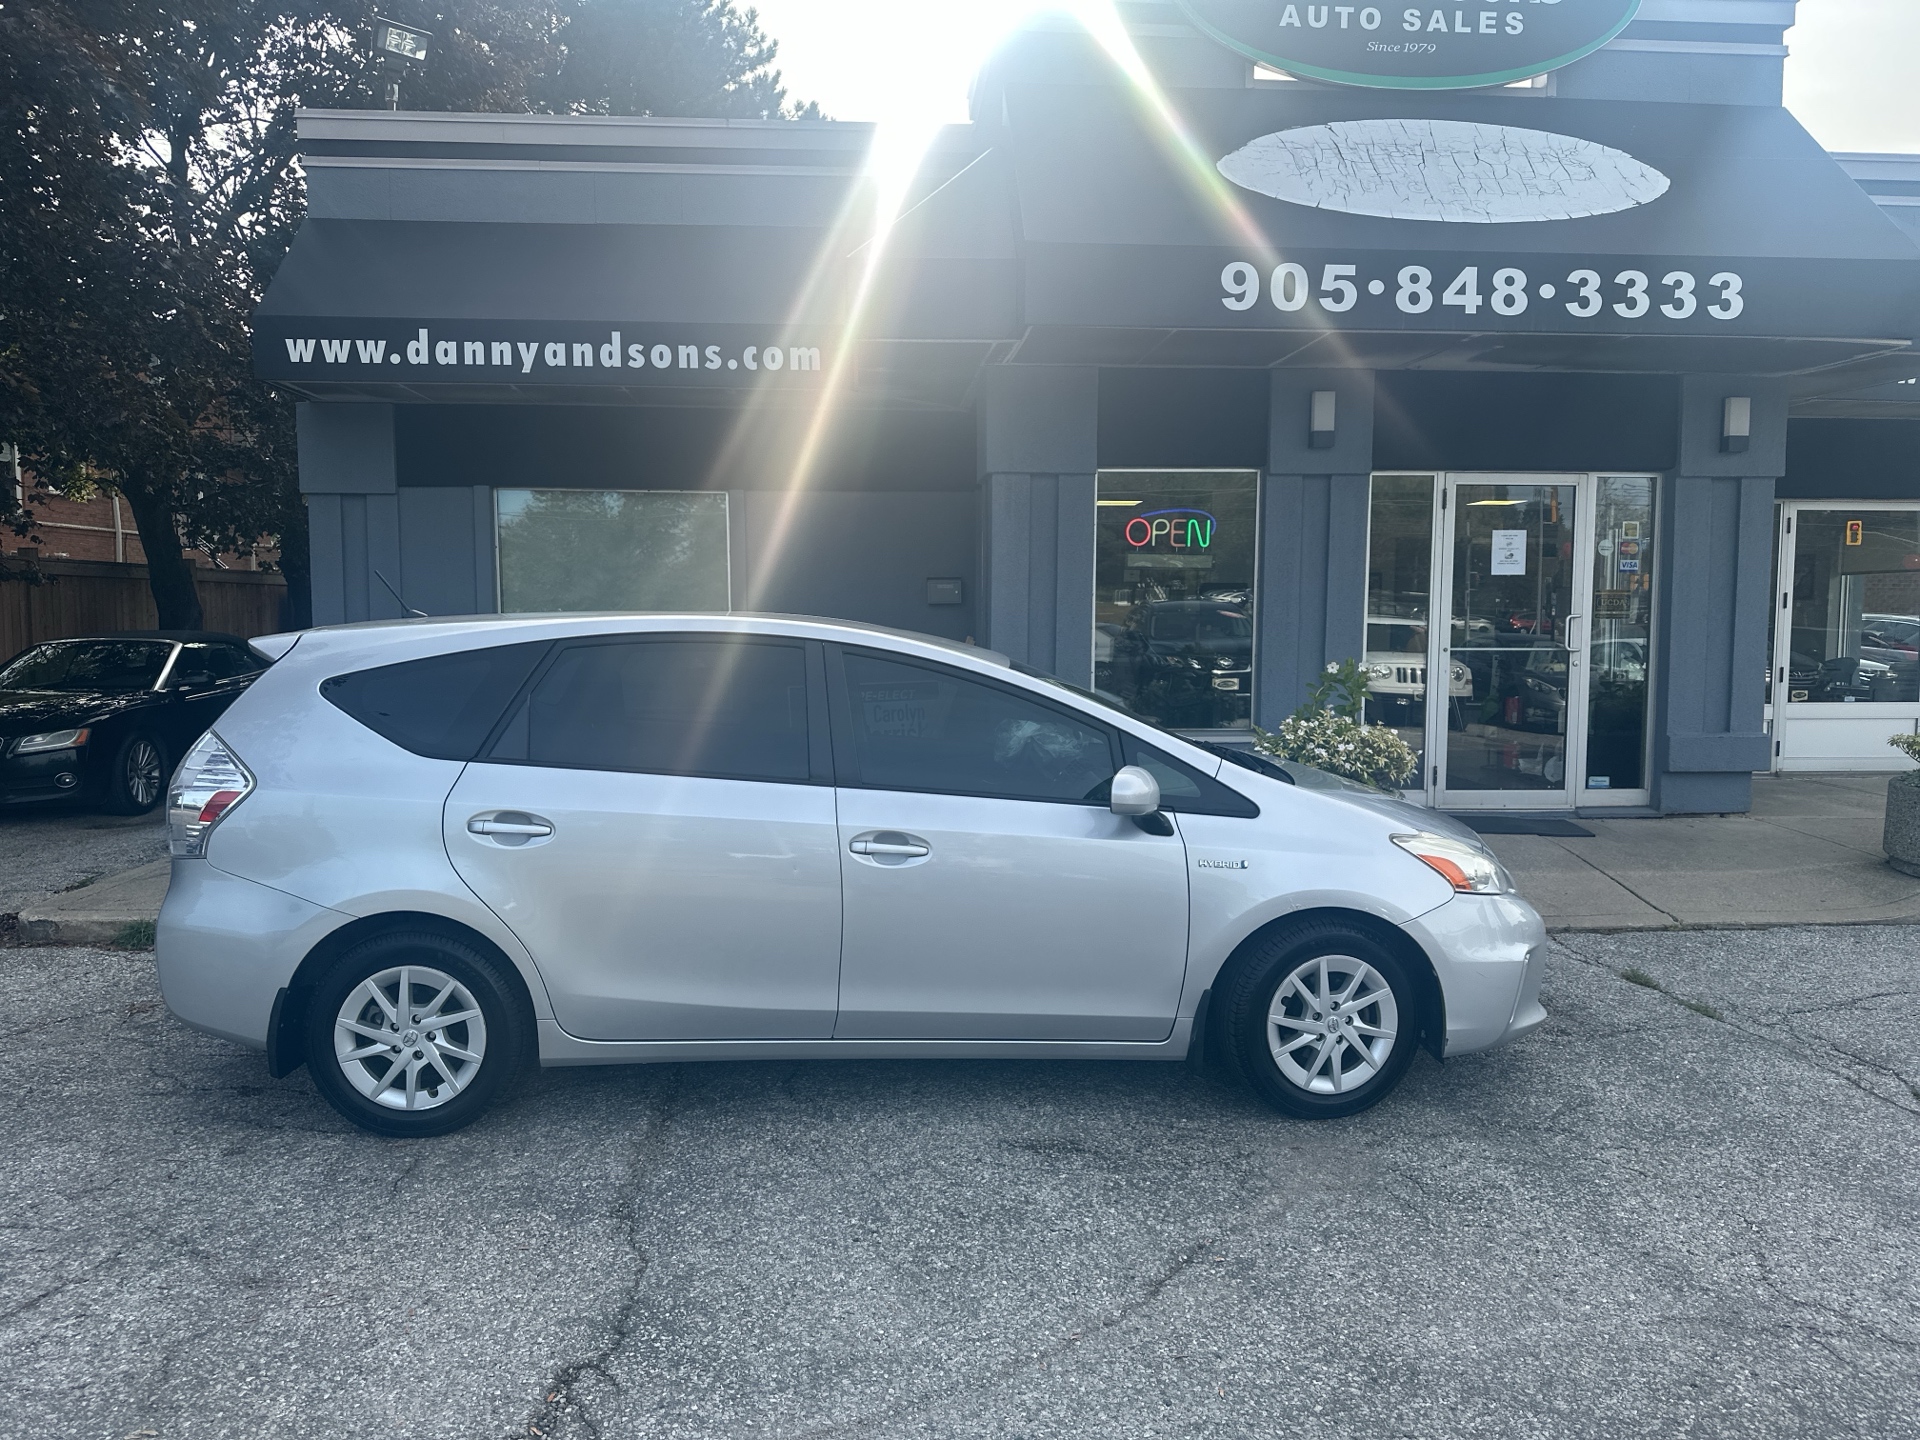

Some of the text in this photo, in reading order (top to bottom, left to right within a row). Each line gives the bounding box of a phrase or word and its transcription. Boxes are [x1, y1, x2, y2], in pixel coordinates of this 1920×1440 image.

[1279, 4, 1524, 35] AUTO SALES
[1366, 41, 1437, 54] Since 1979
[285, 328, 821, 373] www.dannyandsons.com
[1125, 517, 1211, 548] OPEN
[1621, 561, 1638, 569] VISA
[1198, 859, 1240, 869] HYBRID
